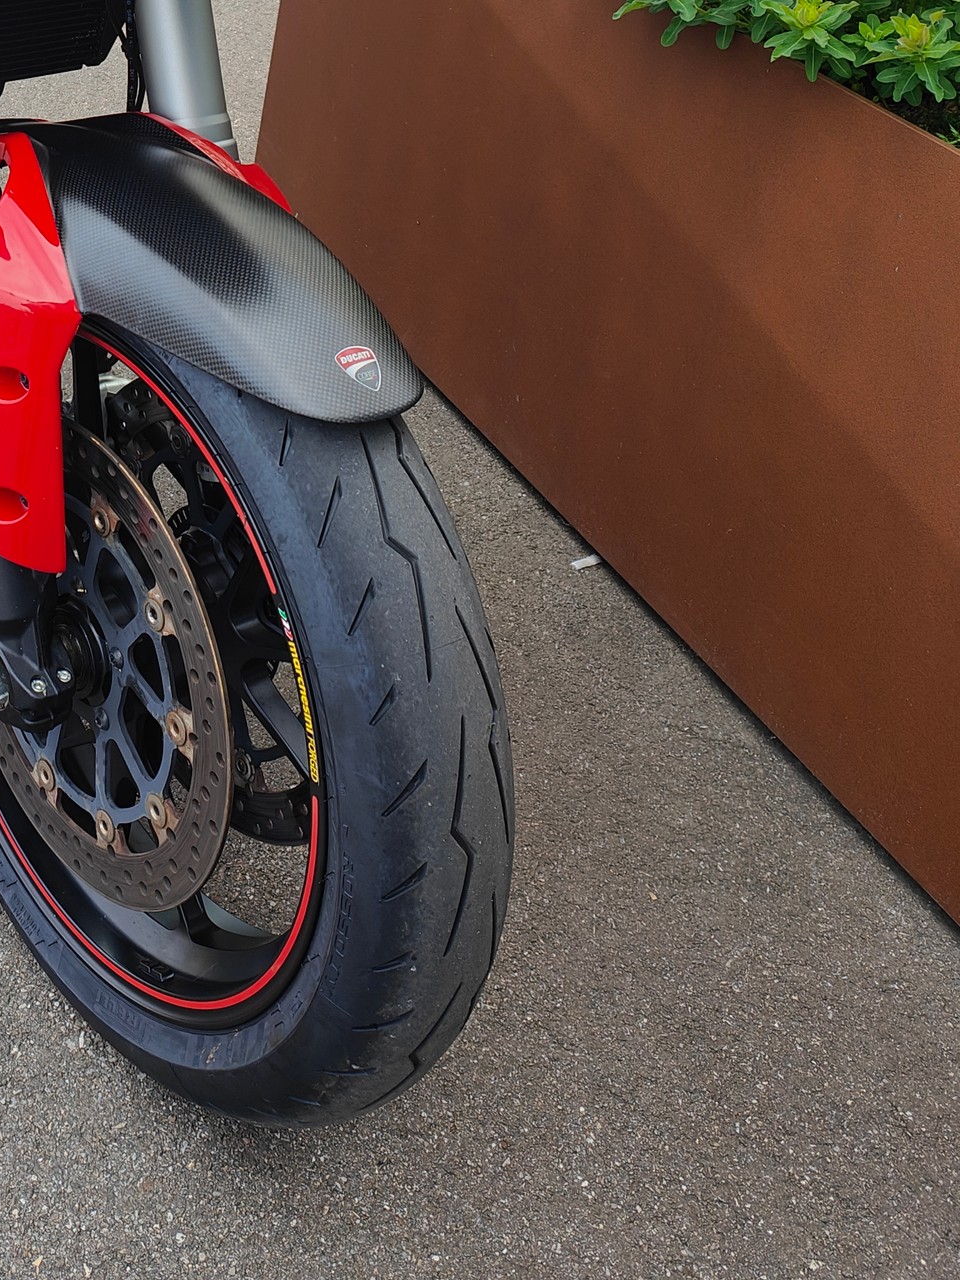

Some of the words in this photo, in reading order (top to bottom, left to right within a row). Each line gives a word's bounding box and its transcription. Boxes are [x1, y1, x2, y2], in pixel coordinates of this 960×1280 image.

[340, 350, 371, 364] DUCATI
[288, 640, 315, 737] marchesini
[306, 736, 320, 784] FORGED
